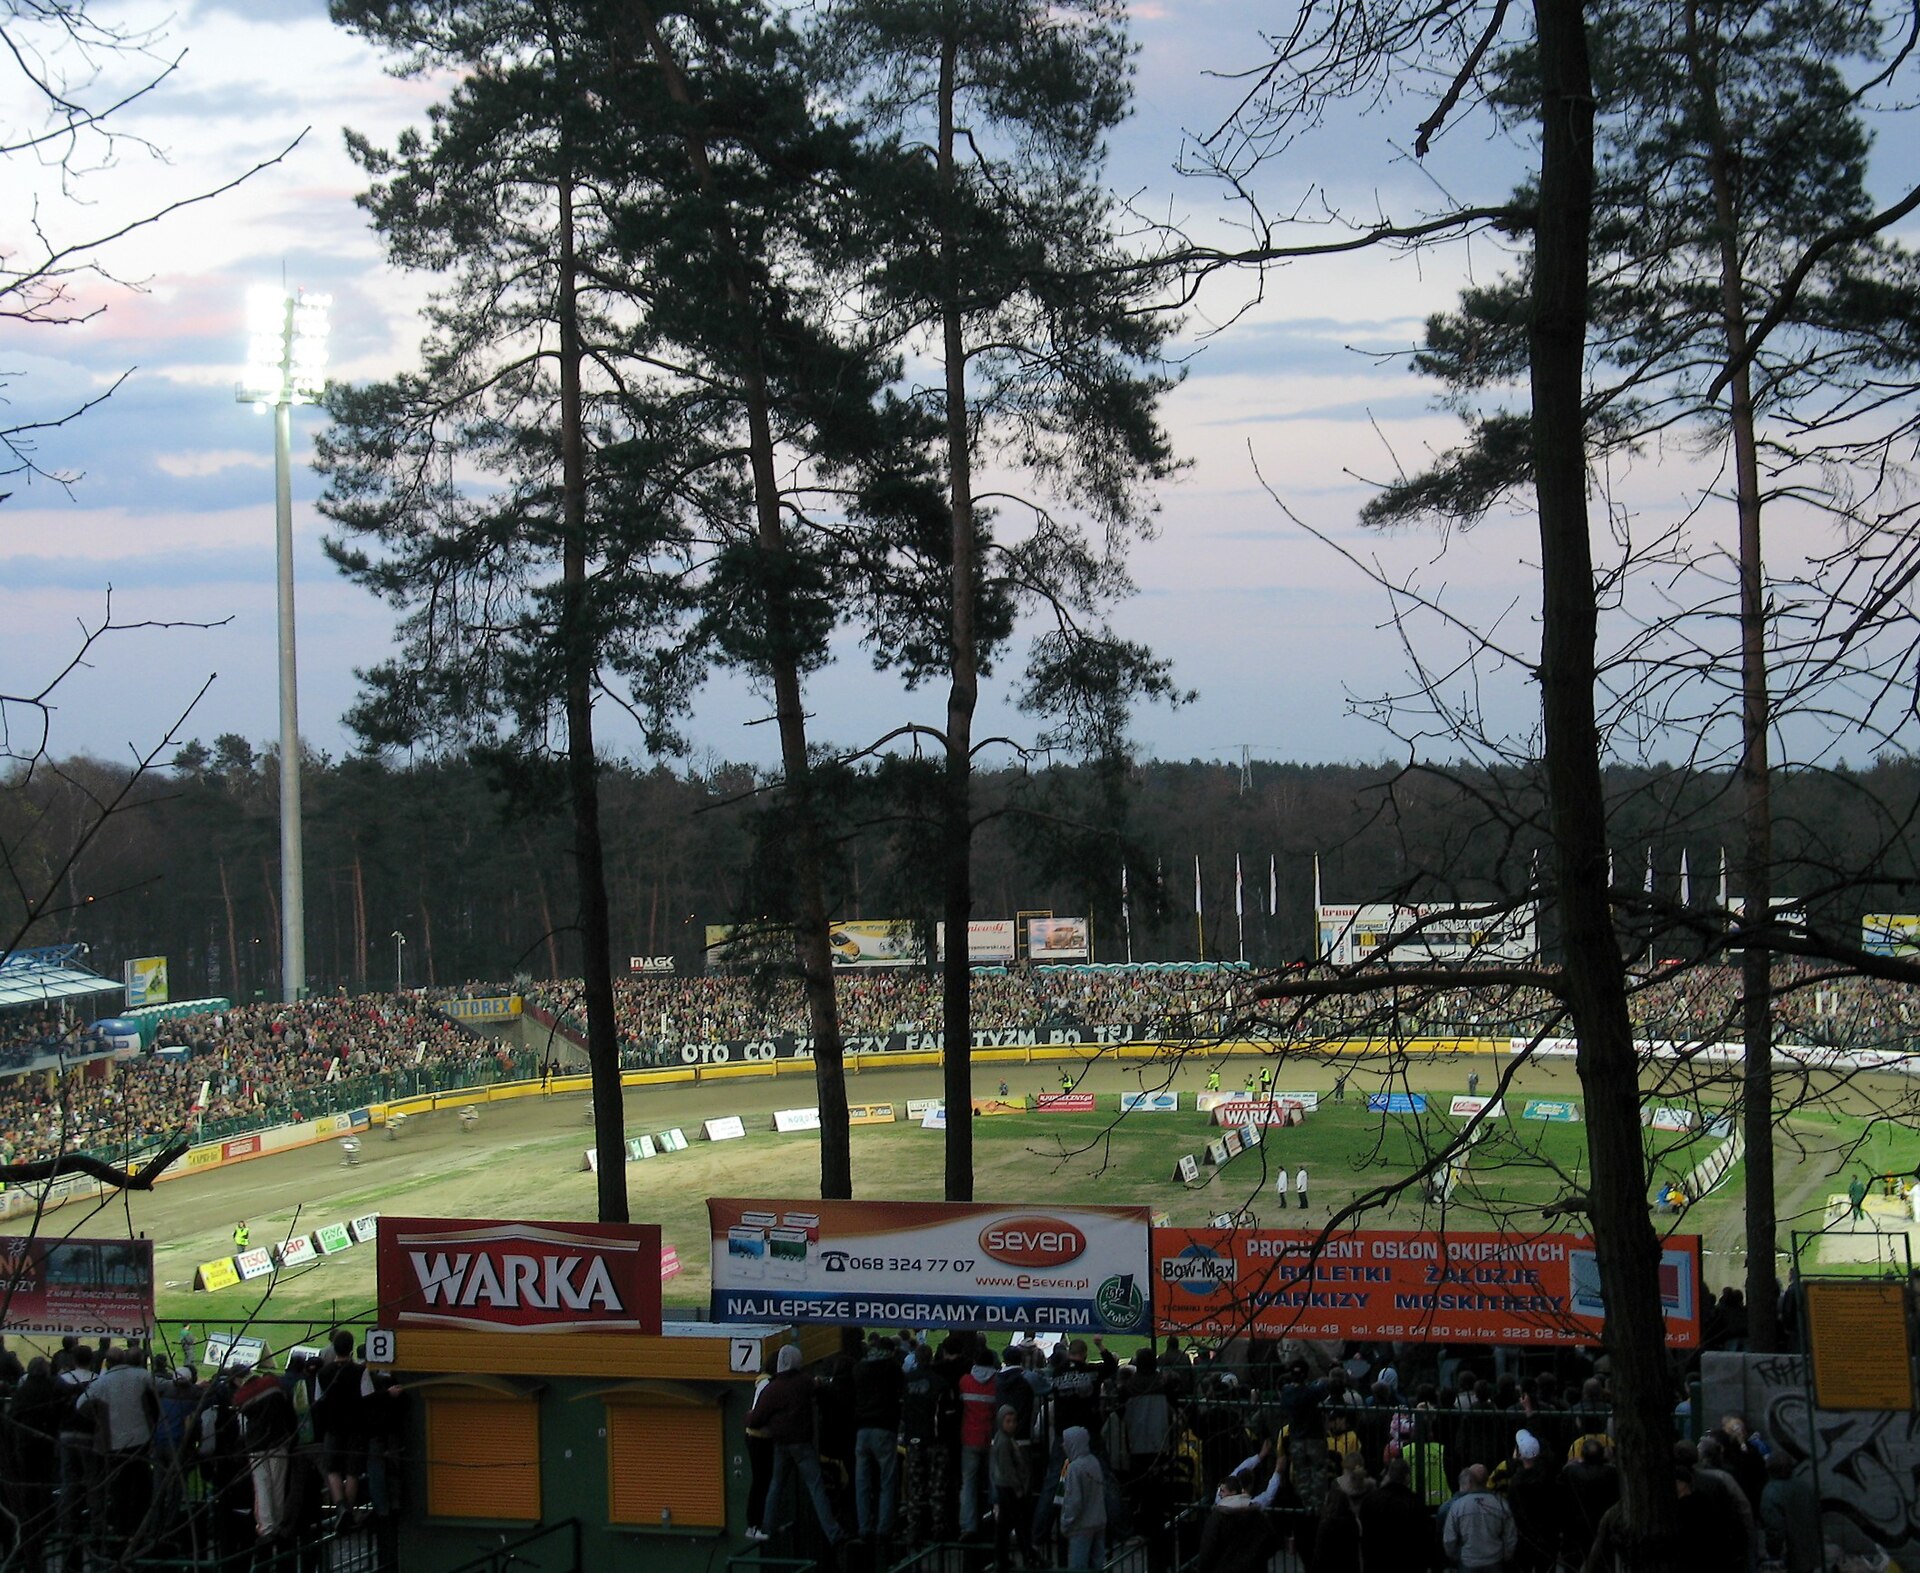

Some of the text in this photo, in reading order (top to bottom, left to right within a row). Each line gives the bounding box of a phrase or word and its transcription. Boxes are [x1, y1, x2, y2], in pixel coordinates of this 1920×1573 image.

[682, 1042, 730, 1064] OTO
[744, 1040, 777, 1061] CO
[1050, 1027, 1082, 1045] PO
[1093, 1023, 1133, 1044] TEJ
[1224, 1109, 1281, 1124] WARKA
[988, 1231, 1076, 1252] seven
[1372, 1241, 1438, 1260] OSŁON
[1447, 1242, 1565, 1261] OKIENNYCH
[240, 1251, 268, 1268] TESCO
[850, 1257, 975, 1273] 068 324 77 07
[1163, 1261, 1234, 1279] Bow-Max
[409, 1251, 623, 1311] WARKA
[728, 1298, 1090, 1325] NAJLEPSZE PROGRAMY DLA FIRM
[1394, 1293, 1565, 1312] MOSKITIERY
[1320, 1325, 1339, 1334] 48
[1502, 1328, 1530, 1338] 323
[1534, 1329, 1553, 1338] 02
[373, 1336, 387, 1356] 8
[737, 1345, 752, 1366] 7
